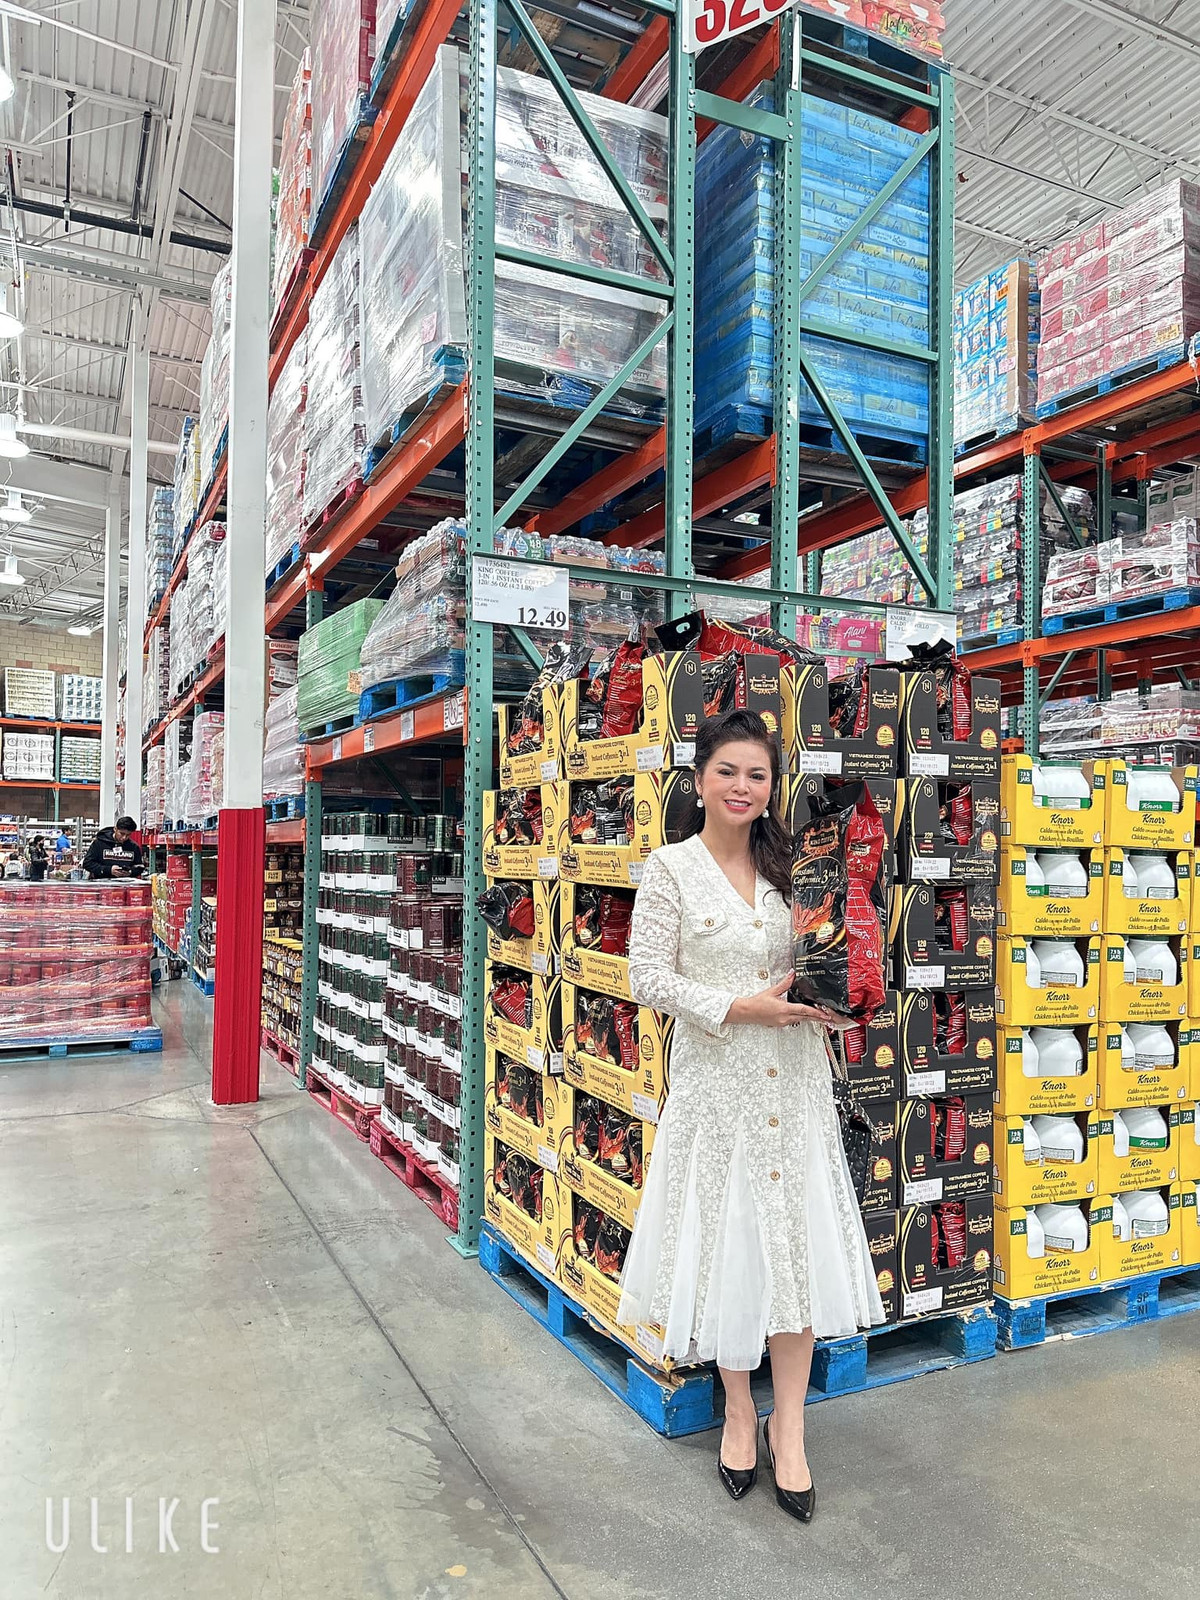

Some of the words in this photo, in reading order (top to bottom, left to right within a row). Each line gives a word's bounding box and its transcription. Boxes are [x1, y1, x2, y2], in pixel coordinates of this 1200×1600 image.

[495, 569, 519, 577] COFFEE
[1132, 585, 1162, 596] ALMONDS
[518, 607, 566, 628] 12.49
[1050, 814, 1074, 824] Knorr
[1142, 814, 1166, 824] Knorr
[1046, 904, 1071, 913] Knorr
[1139, 903, 1161, 913] Knorr
[1046, 991, 1070, 1001] Knorr
[1140, 989, 1163, 998] Knorr
[1138, 1074, 1161, 1084] Knorr
[1041, 1080, 1067, 1090] Knorr
[1130, 1158, 1152, 1168] Knorr
[1043, 1169, 1068, 1179] Knorr
[1131, 1242, 1154, 1252] Knorr
[1046, 1259, 1071, 1269] Knorr
[1137, 1292, 1148, 1302] SP
